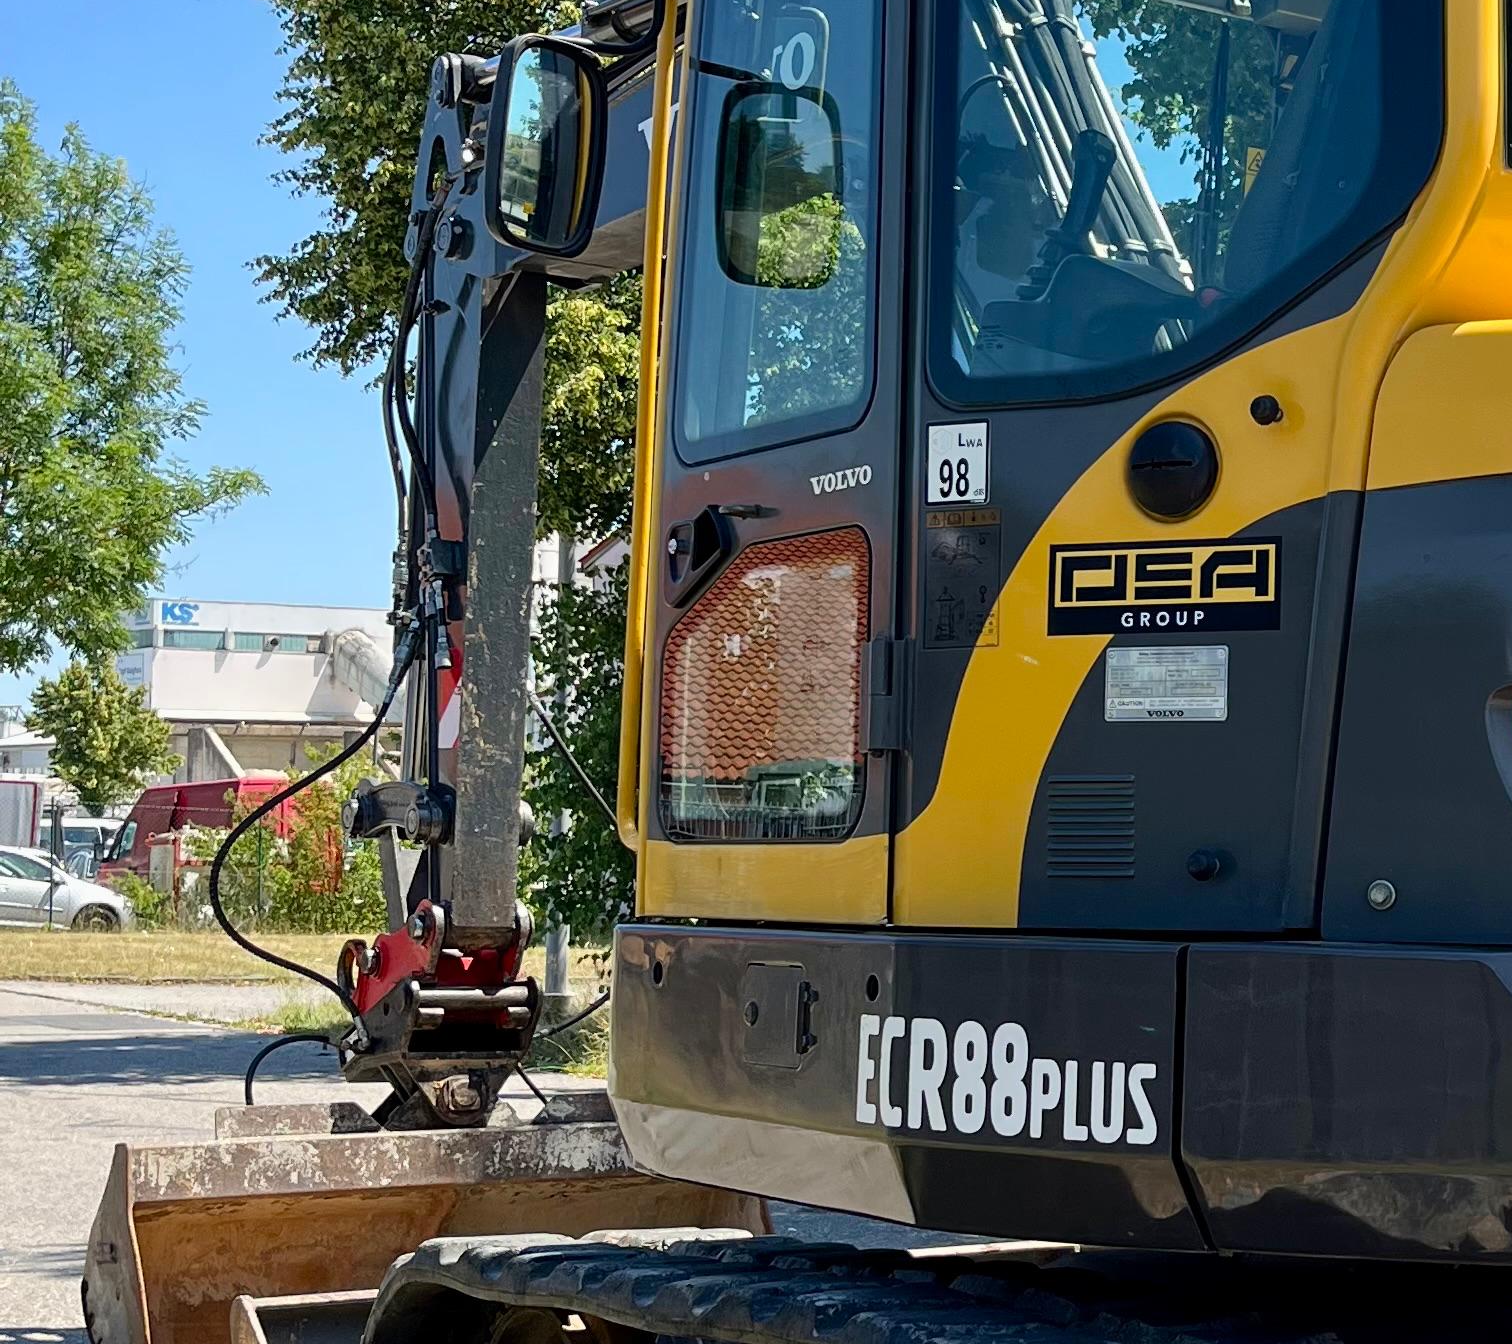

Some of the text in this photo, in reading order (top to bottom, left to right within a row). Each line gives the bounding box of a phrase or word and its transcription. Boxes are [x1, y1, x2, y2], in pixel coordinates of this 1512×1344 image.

[810, 464, 872, 495] VOLVO
[939, 458, 969, 498] 98
[1121, 611, 1204, 627] GROUP
